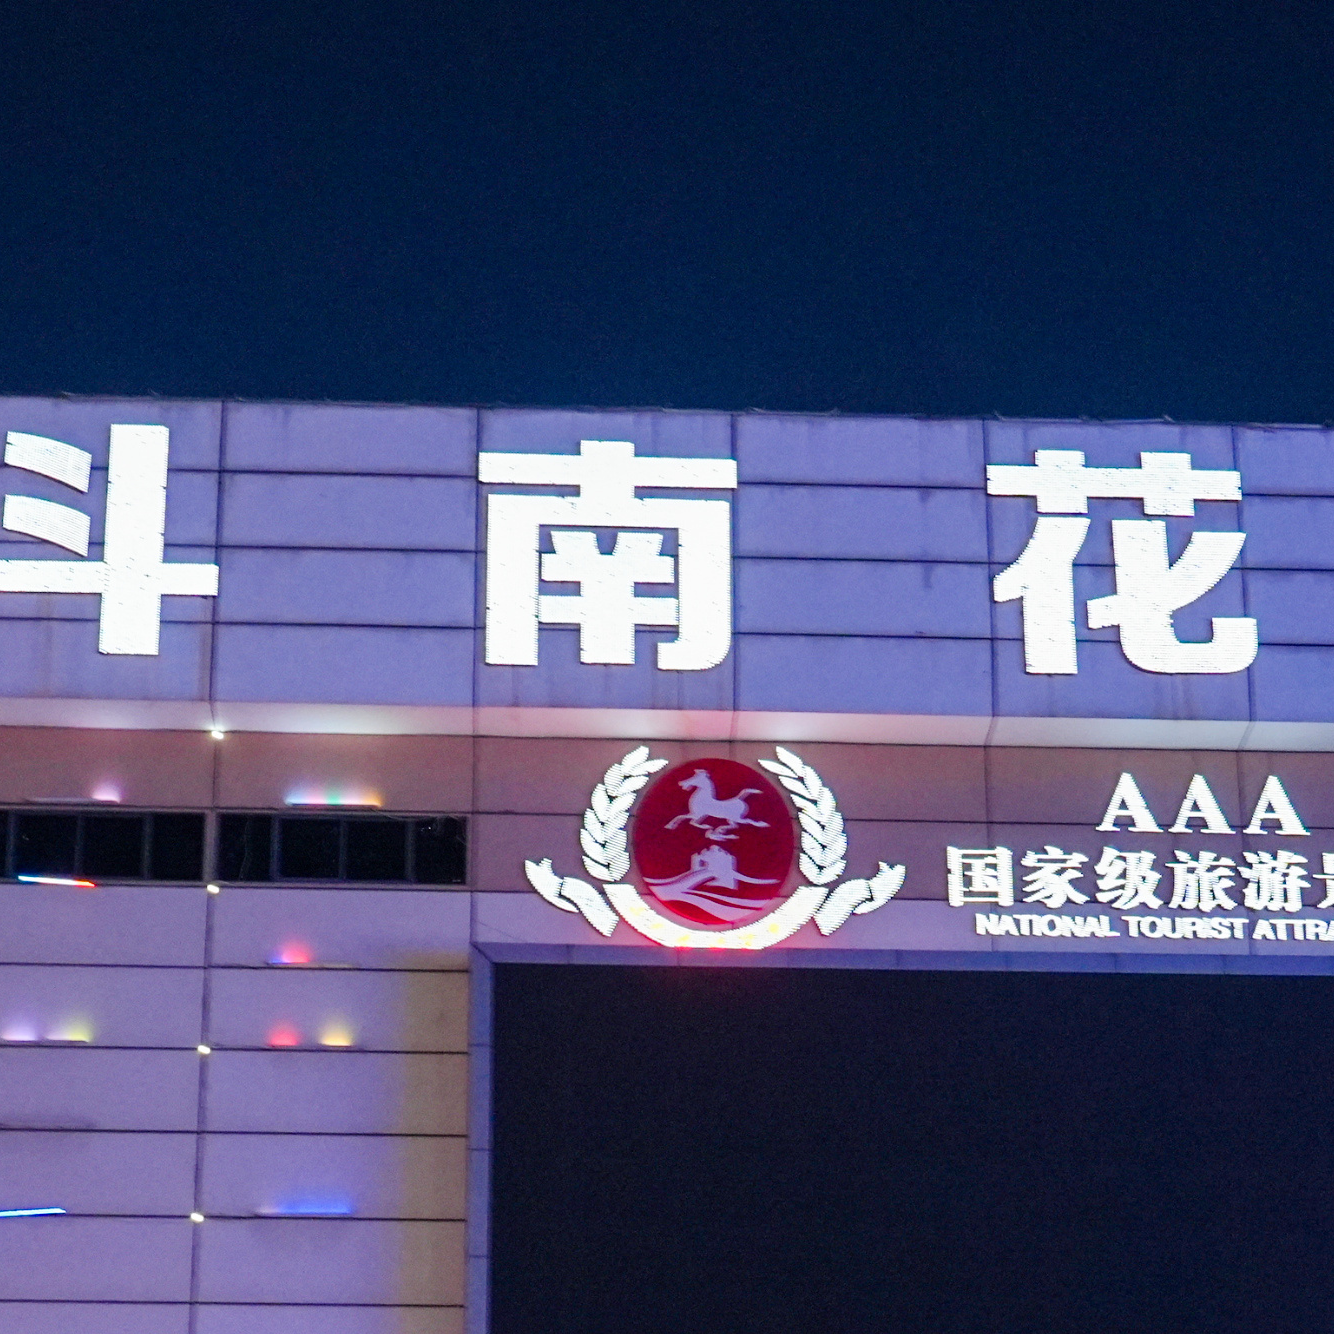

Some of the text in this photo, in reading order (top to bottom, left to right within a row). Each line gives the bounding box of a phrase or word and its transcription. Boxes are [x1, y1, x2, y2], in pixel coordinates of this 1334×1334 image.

[1095, 772, 1311, 836] AAA
[975, 912, 1121, 938] NATIONAL
[1120, 914, 1249, 940] TOURIST
